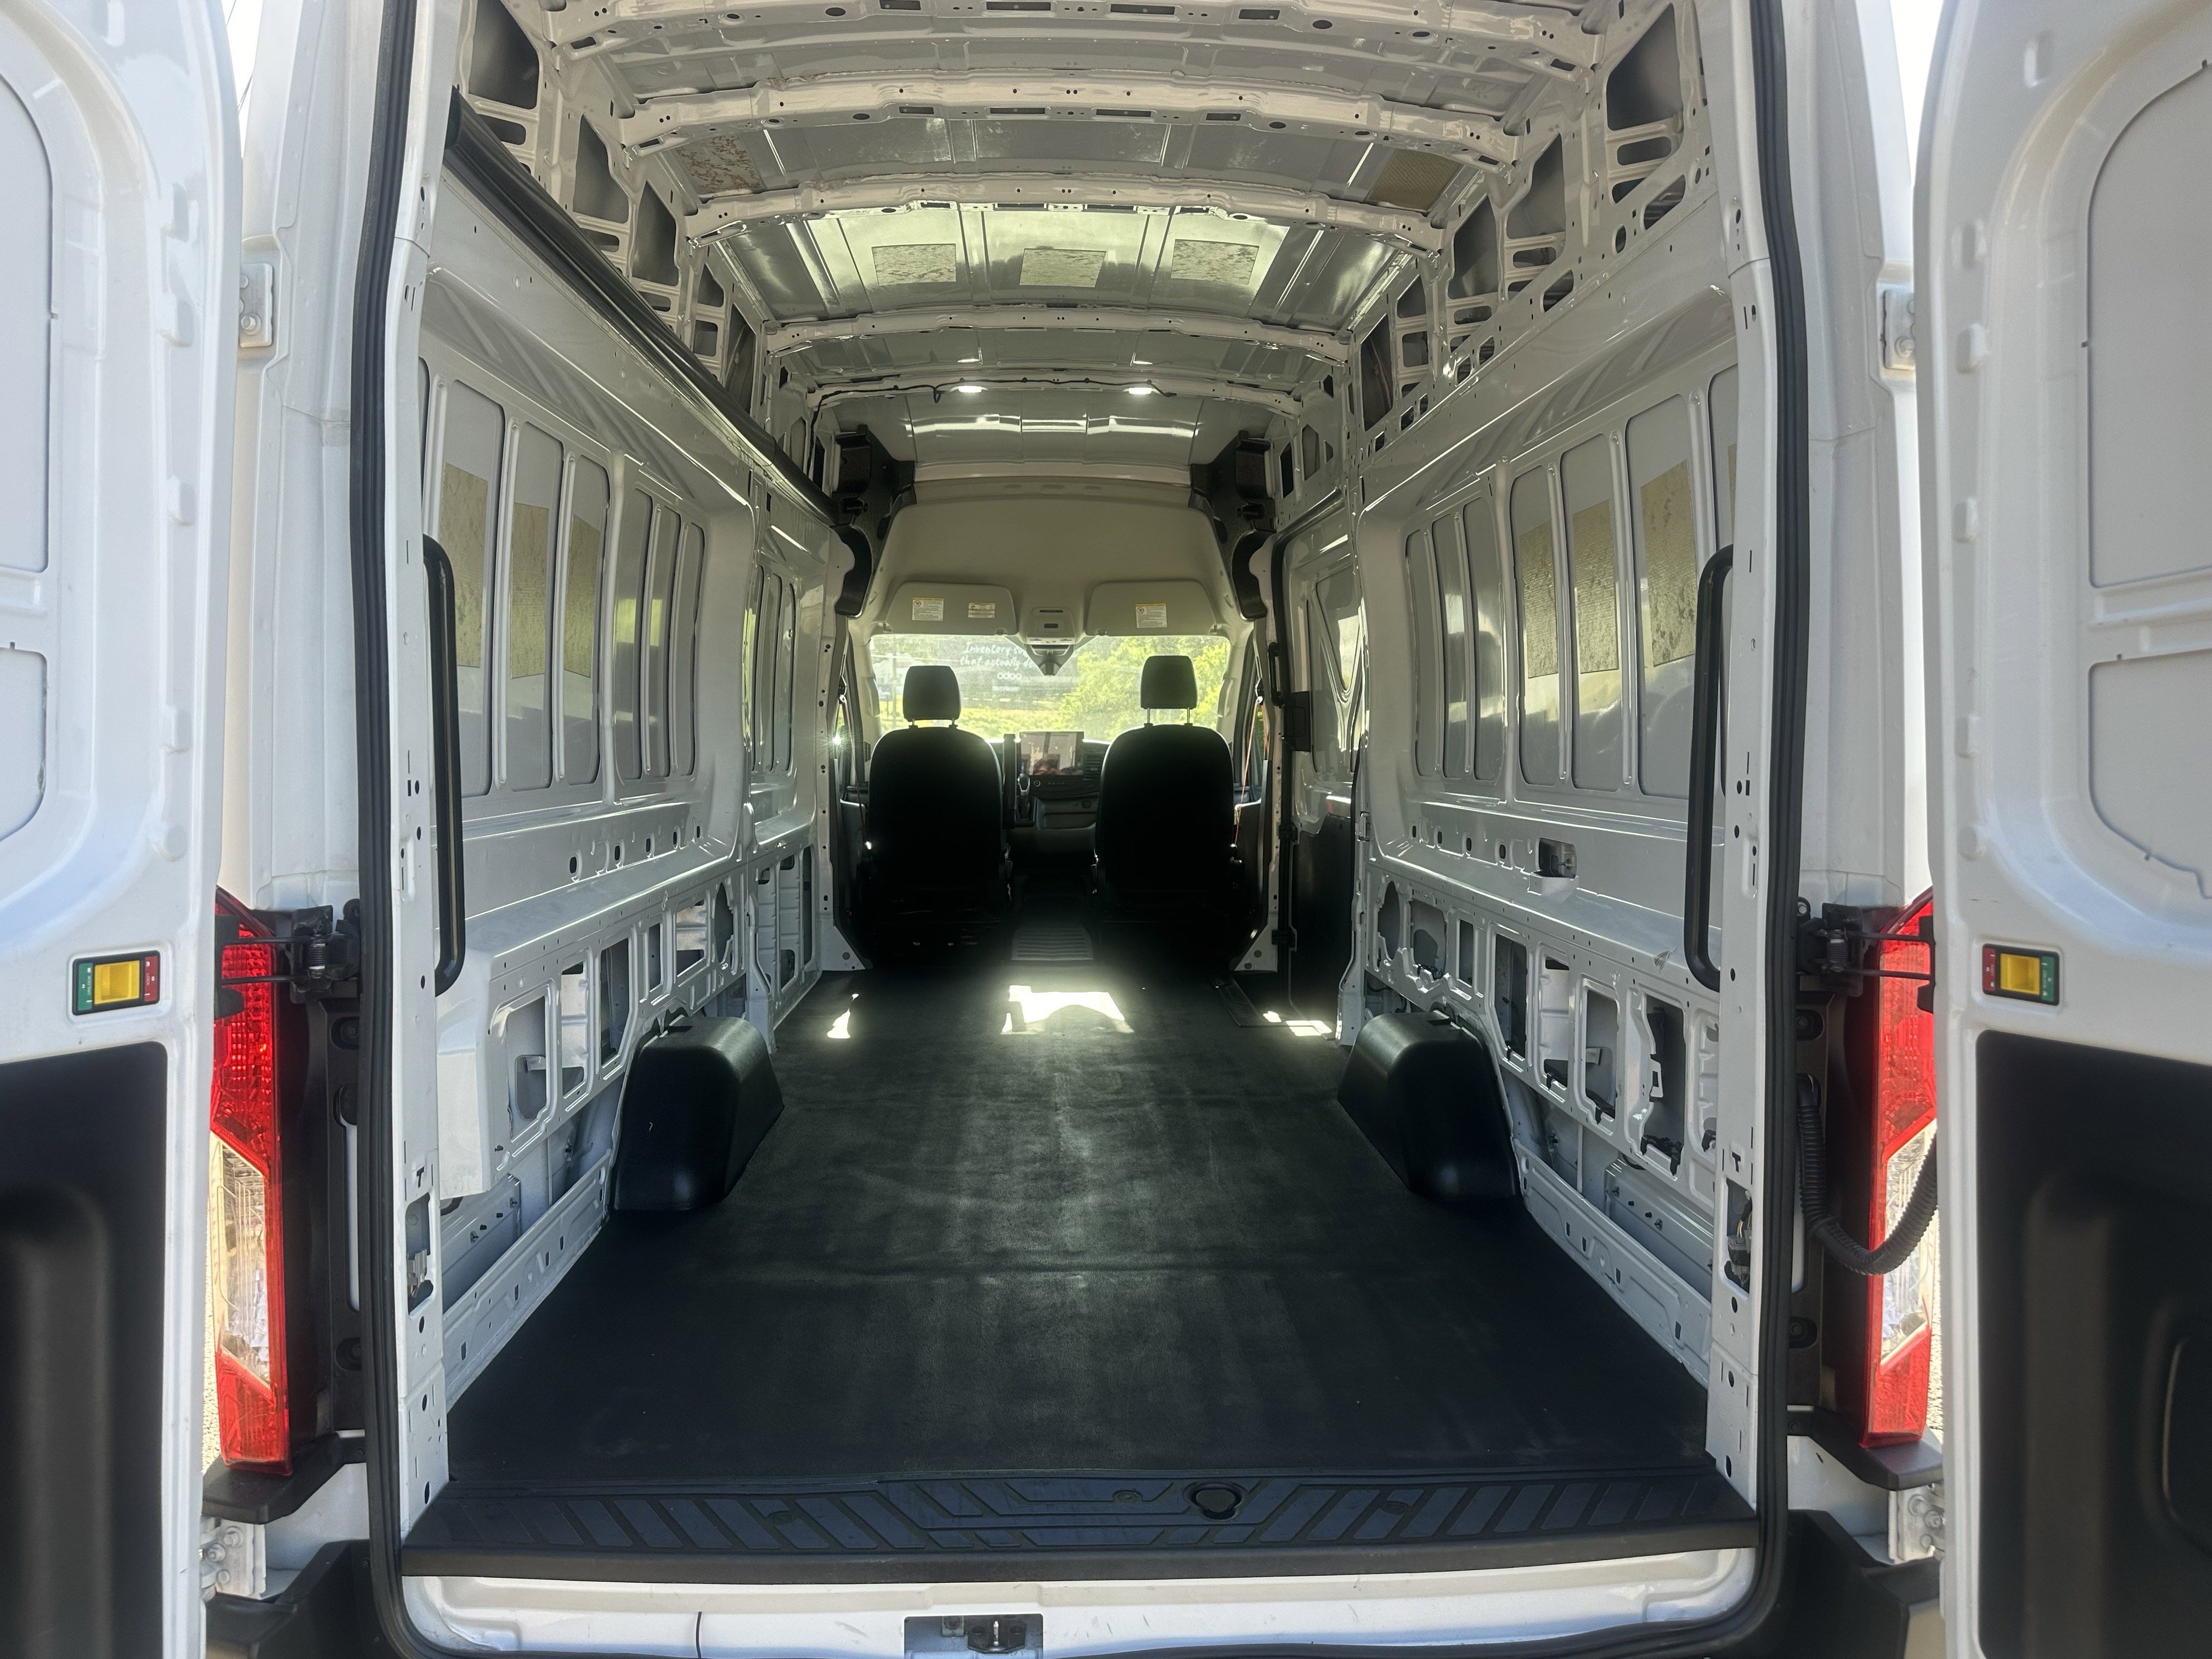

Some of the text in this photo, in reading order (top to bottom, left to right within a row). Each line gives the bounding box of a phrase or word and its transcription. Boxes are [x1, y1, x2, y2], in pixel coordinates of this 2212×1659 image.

[964, 641, 1011, 657] Inventory
[960, 654, 983, 667] that
[985, 657, 1021, 670] actually
[997, 671, 1023, 681] odoo
